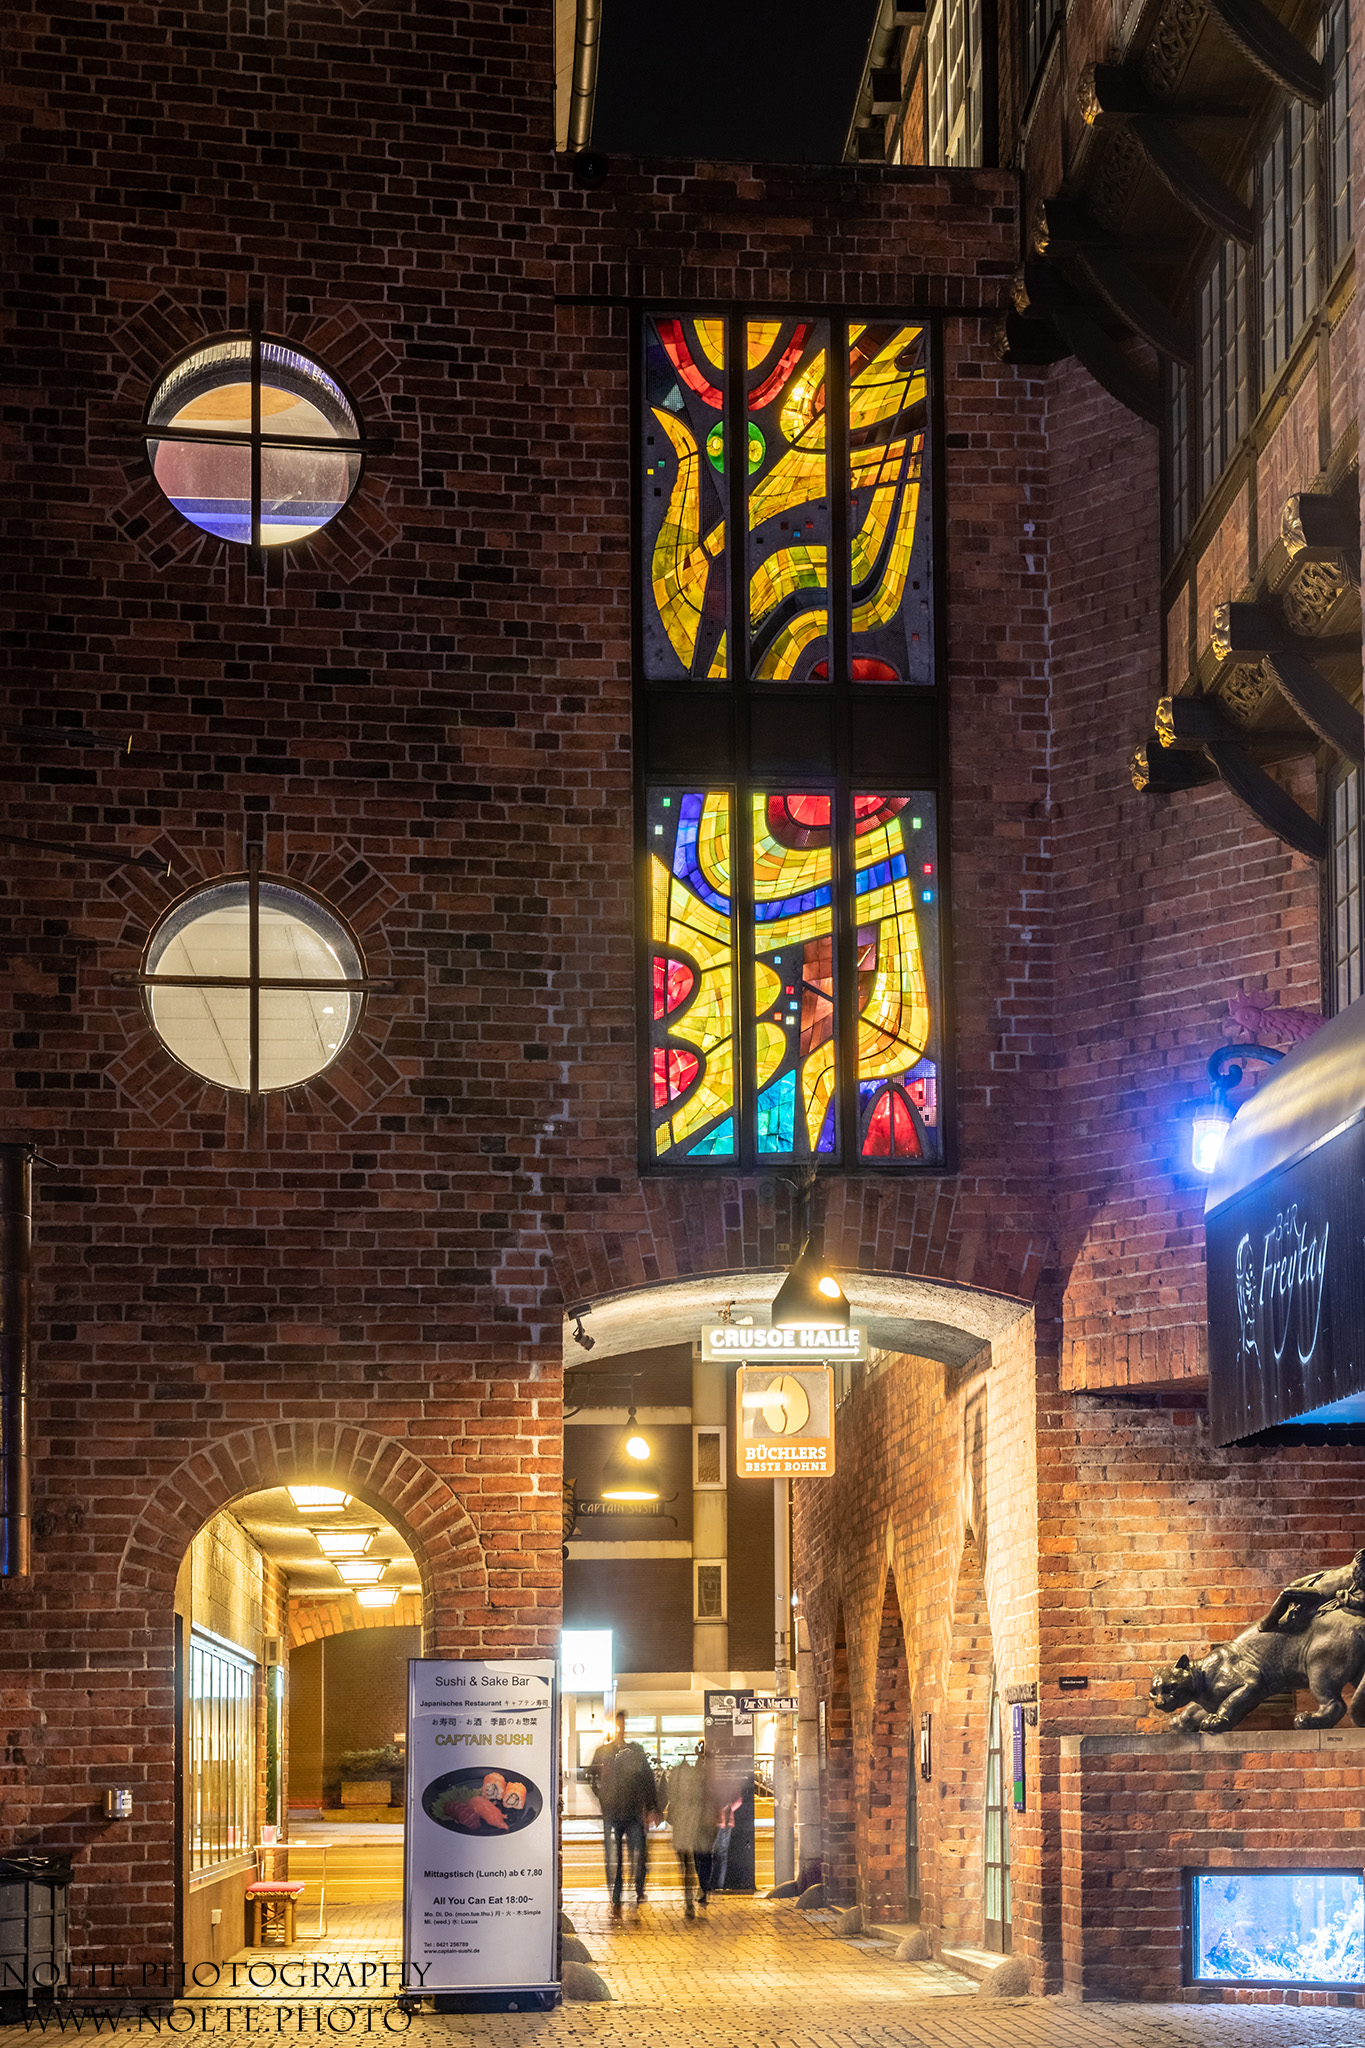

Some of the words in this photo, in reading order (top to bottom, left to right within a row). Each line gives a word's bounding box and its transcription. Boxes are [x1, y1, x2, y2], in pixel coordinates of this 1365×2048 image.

[1275, 1203, 1302, 1242] BAR
[1258, 1221, 1330, 1365] Freytag
[709, 1329, 795, 1348] CRUSOE
[800, 1329, 860, 1347] HALLE
[744, 1443, 827, 1460] BÜCHLERS
[745, 1462, 781, 1472] BESTE
[784, 1461, 827, 1472] BOHNE
[580, 1502, 624, 1514] CAPTAIN
[628, 1502, 659, 1514] SUSHI
[435, 1675, 466, 1687] Sushi
[469, 1675, 478, 1687] &
[480, 1675, 509, 1687] Sake
[511, 1675, 530, 1687] Bar
[419, 1700, 463, 1708] Japanisches
[464, 1700, 502, 1708] Restaurant
[434, 1733, 492, 1747] CAPTAIN
[495, 1733, 533, 1746] SUSHI
[423, 1870, 474, 1879] Mittagstisch
[476, 1869, 507, 1879] (Lunch)
[508, 1869, 519, 1877] ab
[520, 1869, 526, 1877] €
[527, 1868, 543, 1877] 7,80
[433, 1896, 446, 1905] All
[448, 1896, 466, 1905] You
[467, 1896, 486, 1905] Can
[488, 1896, 503, 1904] Eat
